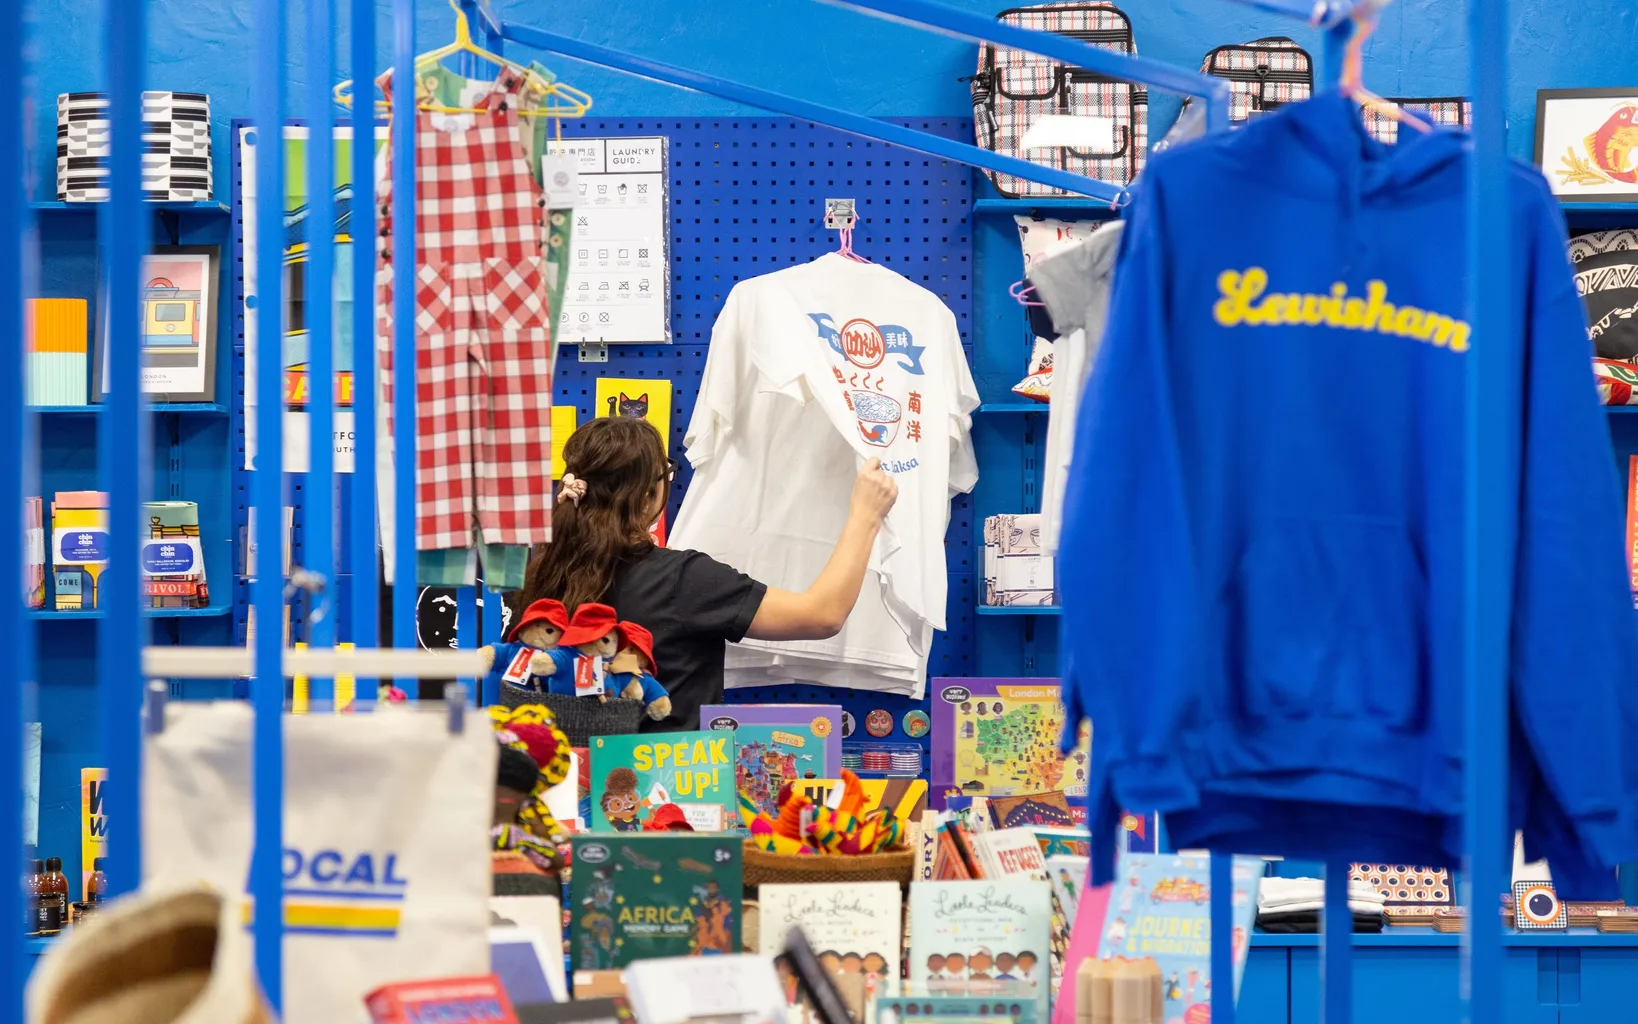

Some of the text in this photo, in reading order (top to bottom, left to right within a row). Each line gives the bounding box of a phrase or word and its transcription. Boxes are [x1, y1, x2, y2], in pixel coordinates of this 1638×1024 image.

[612, 148, 656, 156] LAUNDRY
[1213, 266, 1471, 352] Lewisham
[886, 332, 908, 348] 美味
[906, 390, 922, 443] 南洋
[1009, 687, 1062, 698] London Ma
[633, 738, 730, 772] SPEAK
[674, 767, 720, 799] UP!
[714, 849, 731, 863] 5+
[268, 848, 407, 888] OCAL
[617, 906, 695, 924] AFRICA
[623, 924, 690, 934] MEMORY GAME
